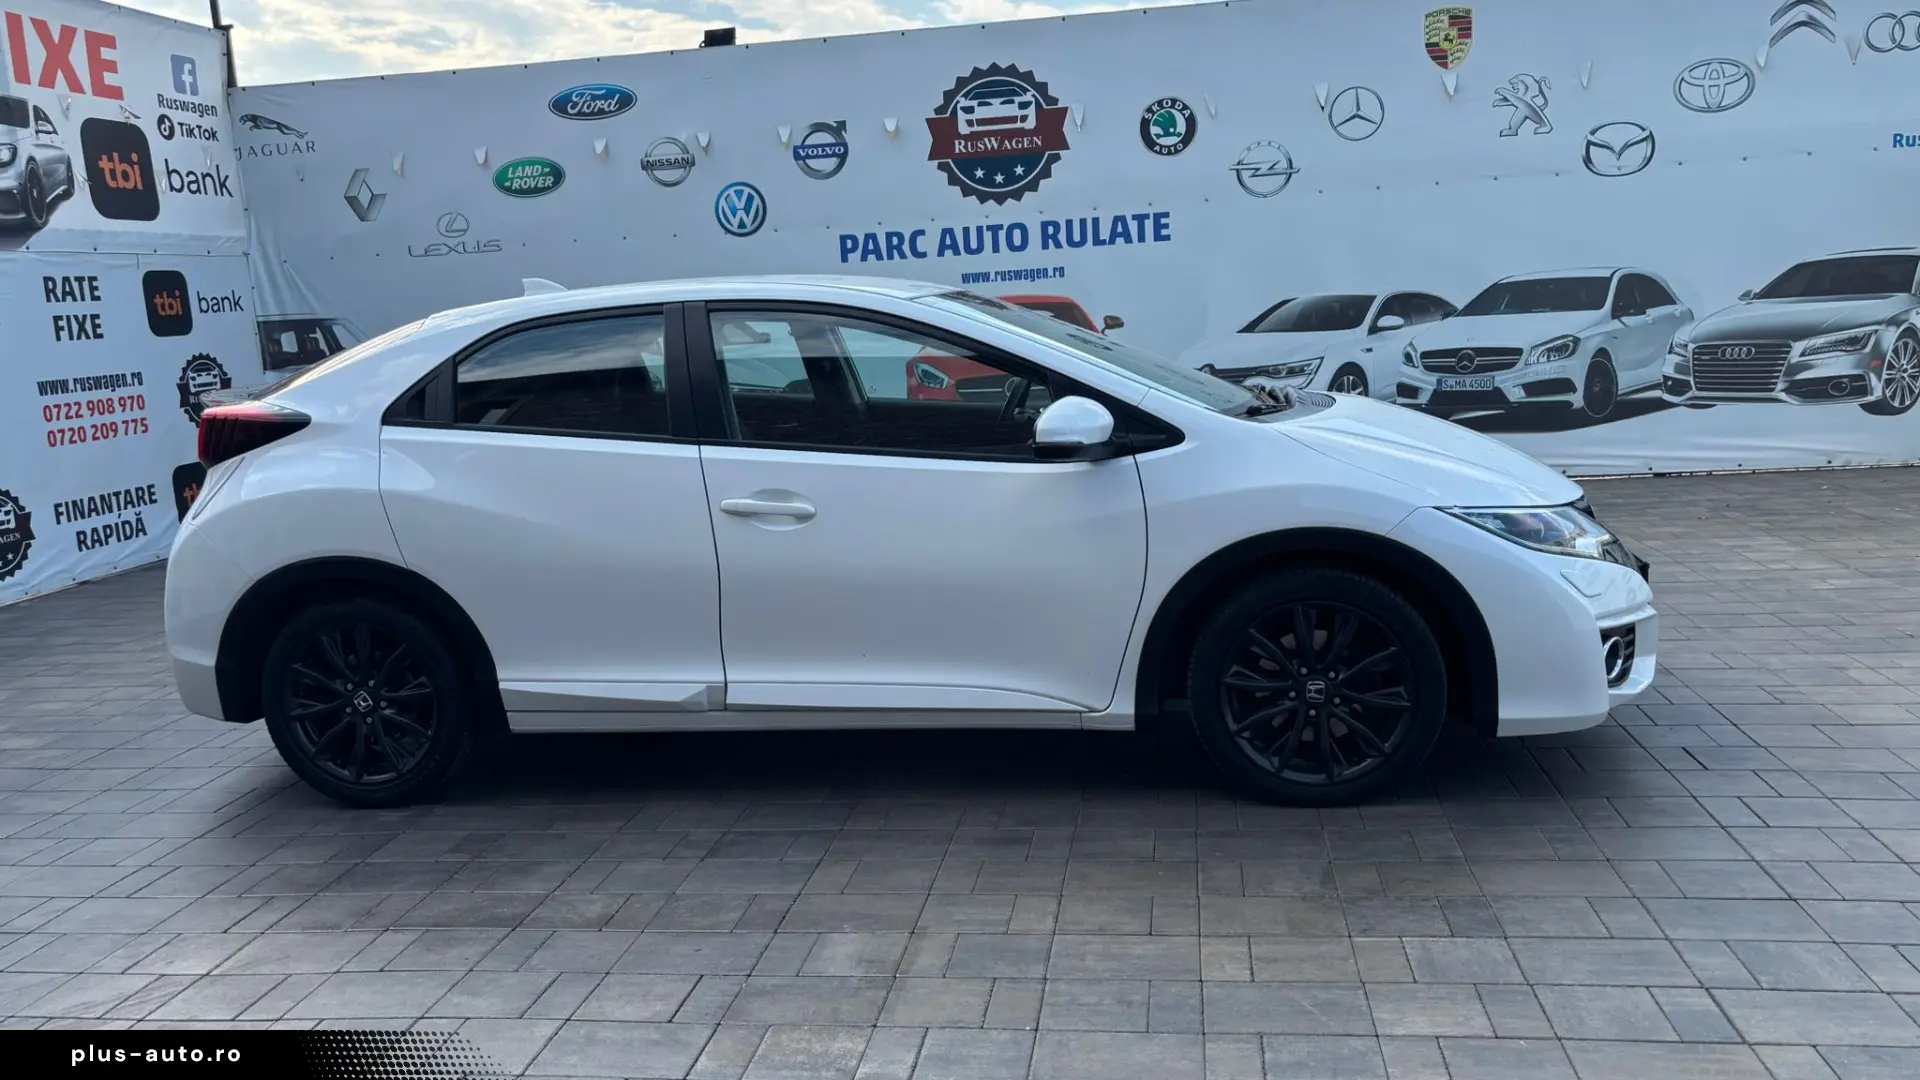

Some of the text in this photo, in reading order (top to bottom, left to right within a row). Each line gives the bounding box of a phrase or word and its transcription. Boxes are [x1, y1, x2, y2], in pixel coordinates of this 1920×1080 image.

[157, 93, 218, 118] Ruswagen
[567, 89, 619, 114] Ford
[178, 122, 220, 142] TikTok
[236, 140, 316, 161] JAGUAR
[797, 145, 845, 157] VOLVO
[1153, 143, 1183, 154] AUTO
[508, 165, 542, 178] LAND
[646, 156, 690, 168] NISSAN
[98, 152, 234, 198] tbi bank
[512, 175, 554, 190] ROVER
[408, 240, 502, 257] LEXUS
[839, 211, 1172, 263] PARC AUTO RULATE
[961, 266, 1066, 285] www.ruswagen.ro
[43, 275, 102, 303] RATE
[153, 289, 245, 317] tbi bank
[52, 313, 104, 342] FIXE
[37, 371, 144, 397] www.ruswagen.ro
[42, 394, 146, 423] 0722 908 970
[47, 417, 149, 448] 0720 209 775
